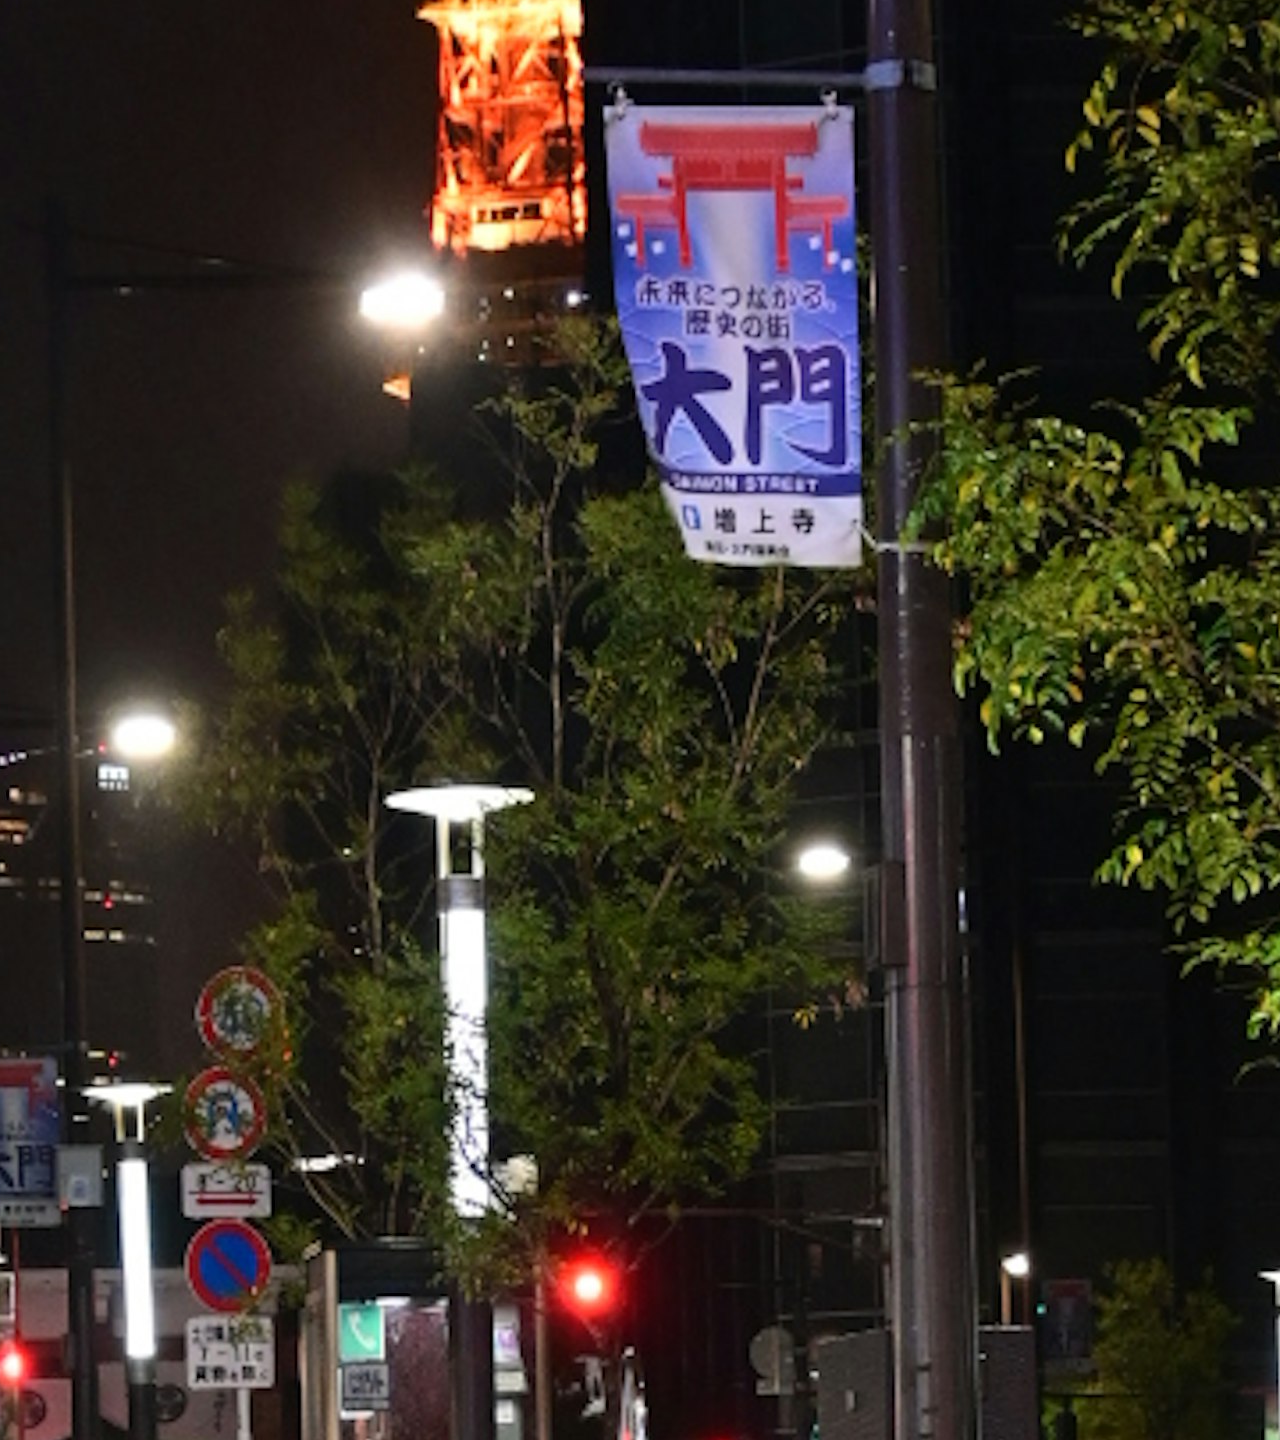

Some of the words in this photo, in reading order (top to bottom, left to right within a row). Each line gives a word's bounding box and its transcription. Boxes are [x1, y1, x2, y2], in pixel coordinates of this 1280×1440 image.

[686, 311, 790, 339] 歴史の街
[641, 341, 847, 466] 大門
[714, 507, 816, 535] 増上寺
